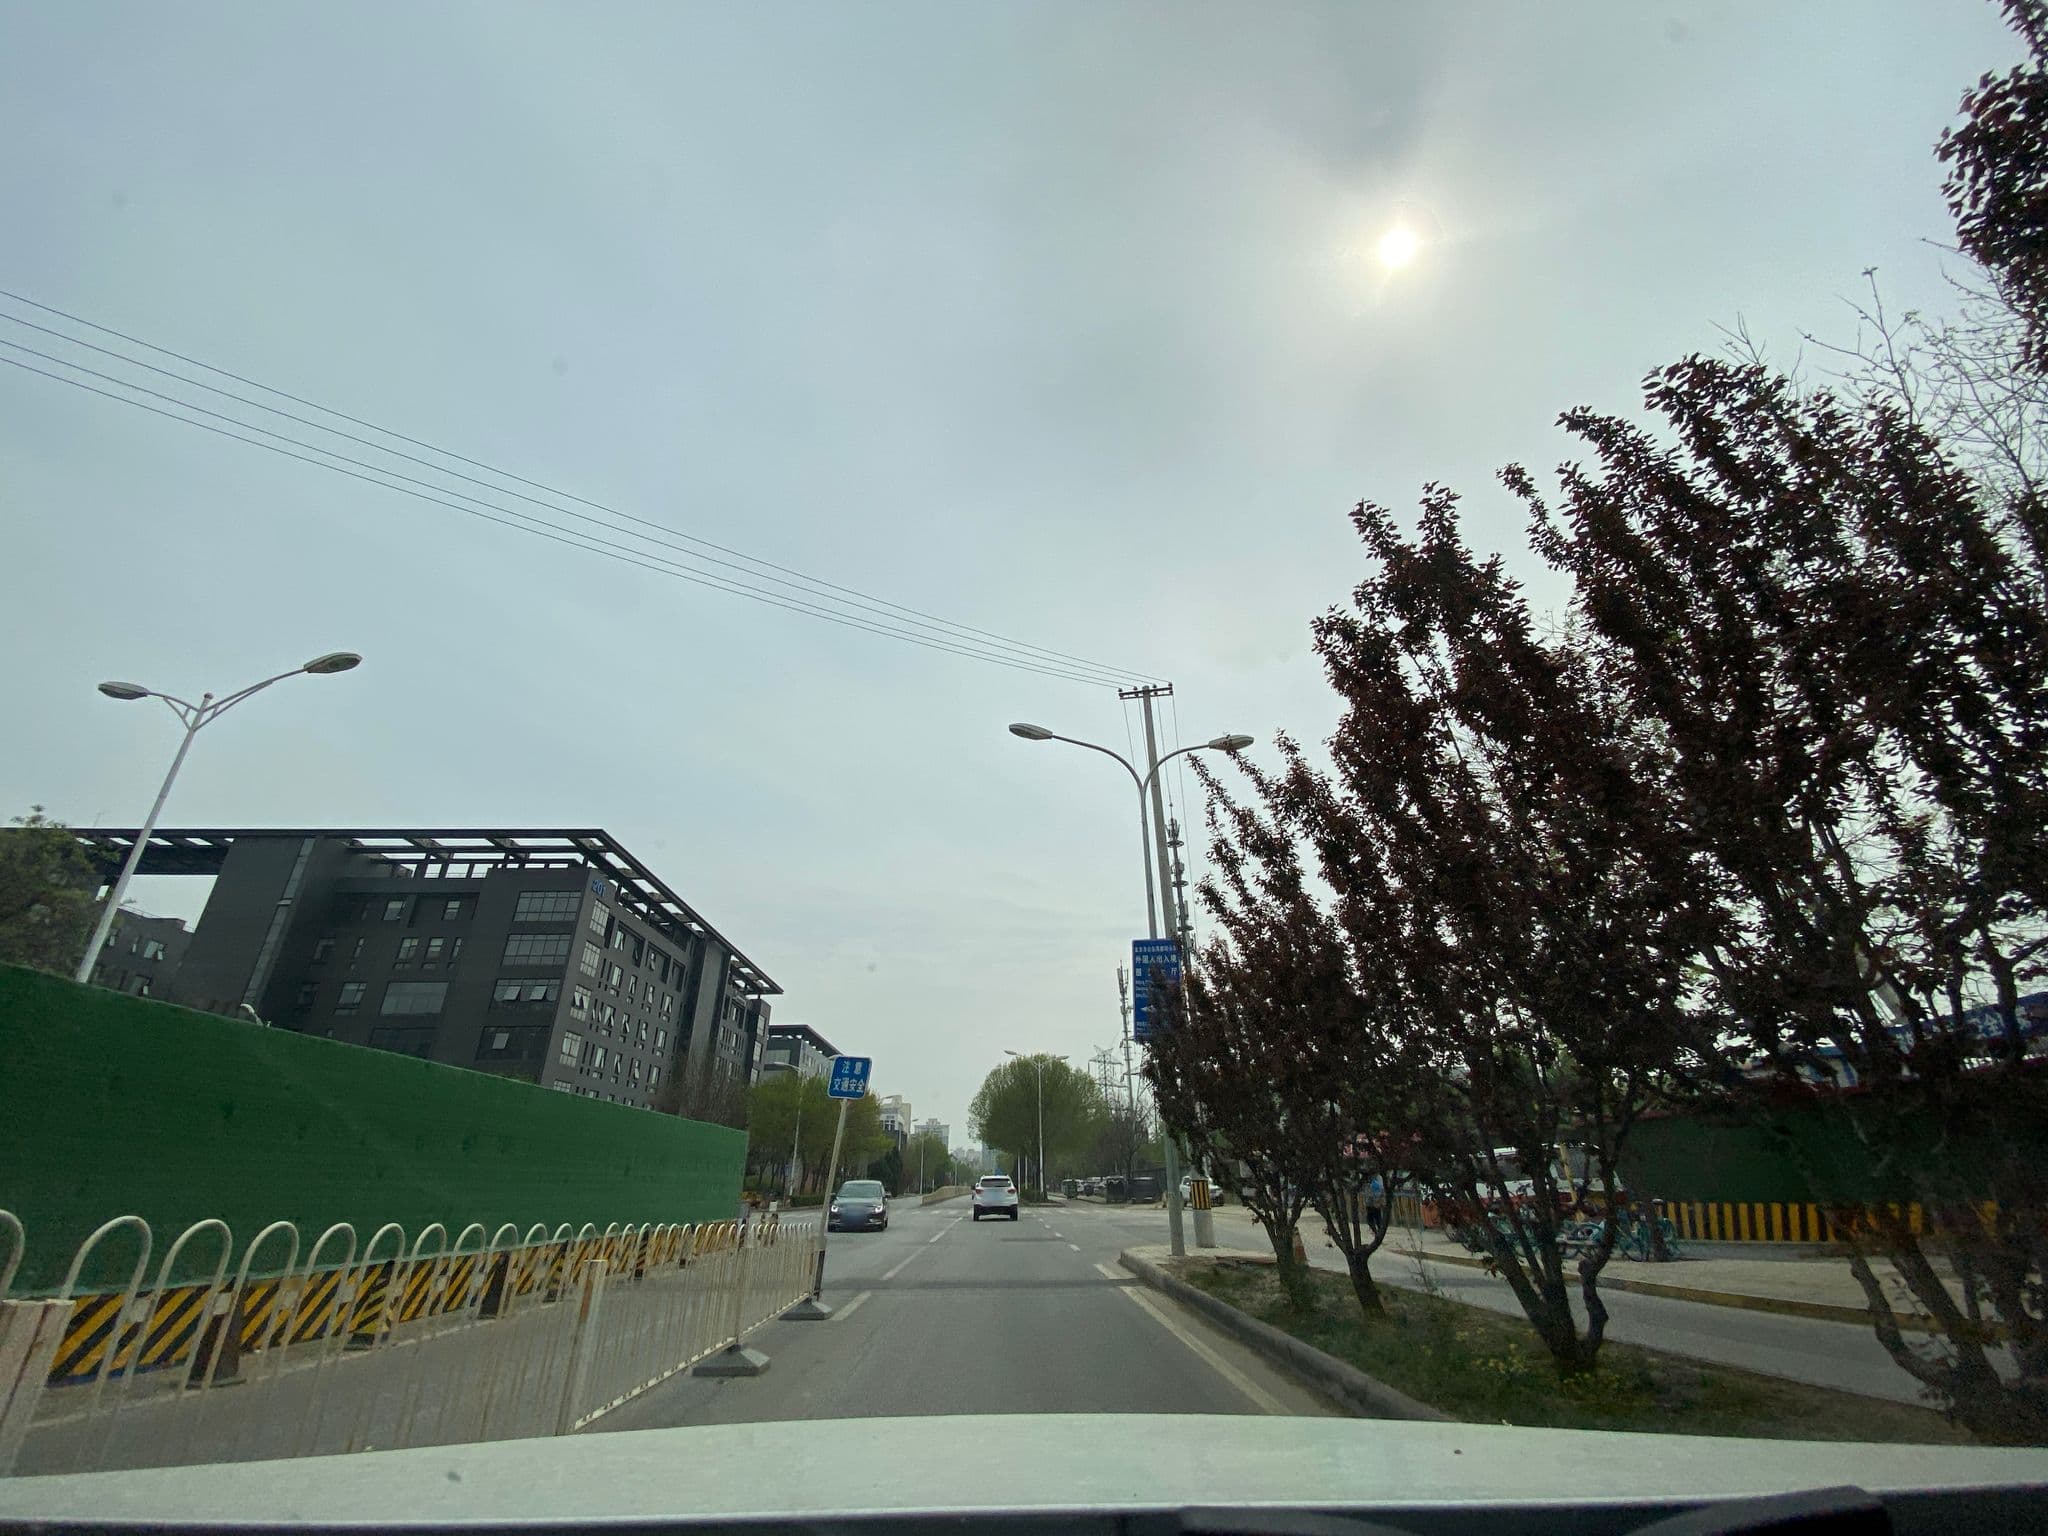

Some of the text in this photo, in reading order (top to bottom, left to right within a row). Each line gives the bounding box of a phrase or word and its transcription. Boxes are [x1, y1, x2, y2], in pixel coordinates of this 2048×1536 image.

[842, 1060, 863, 1075] 注意
[833, 1077, 865, 1093] 交通安全
